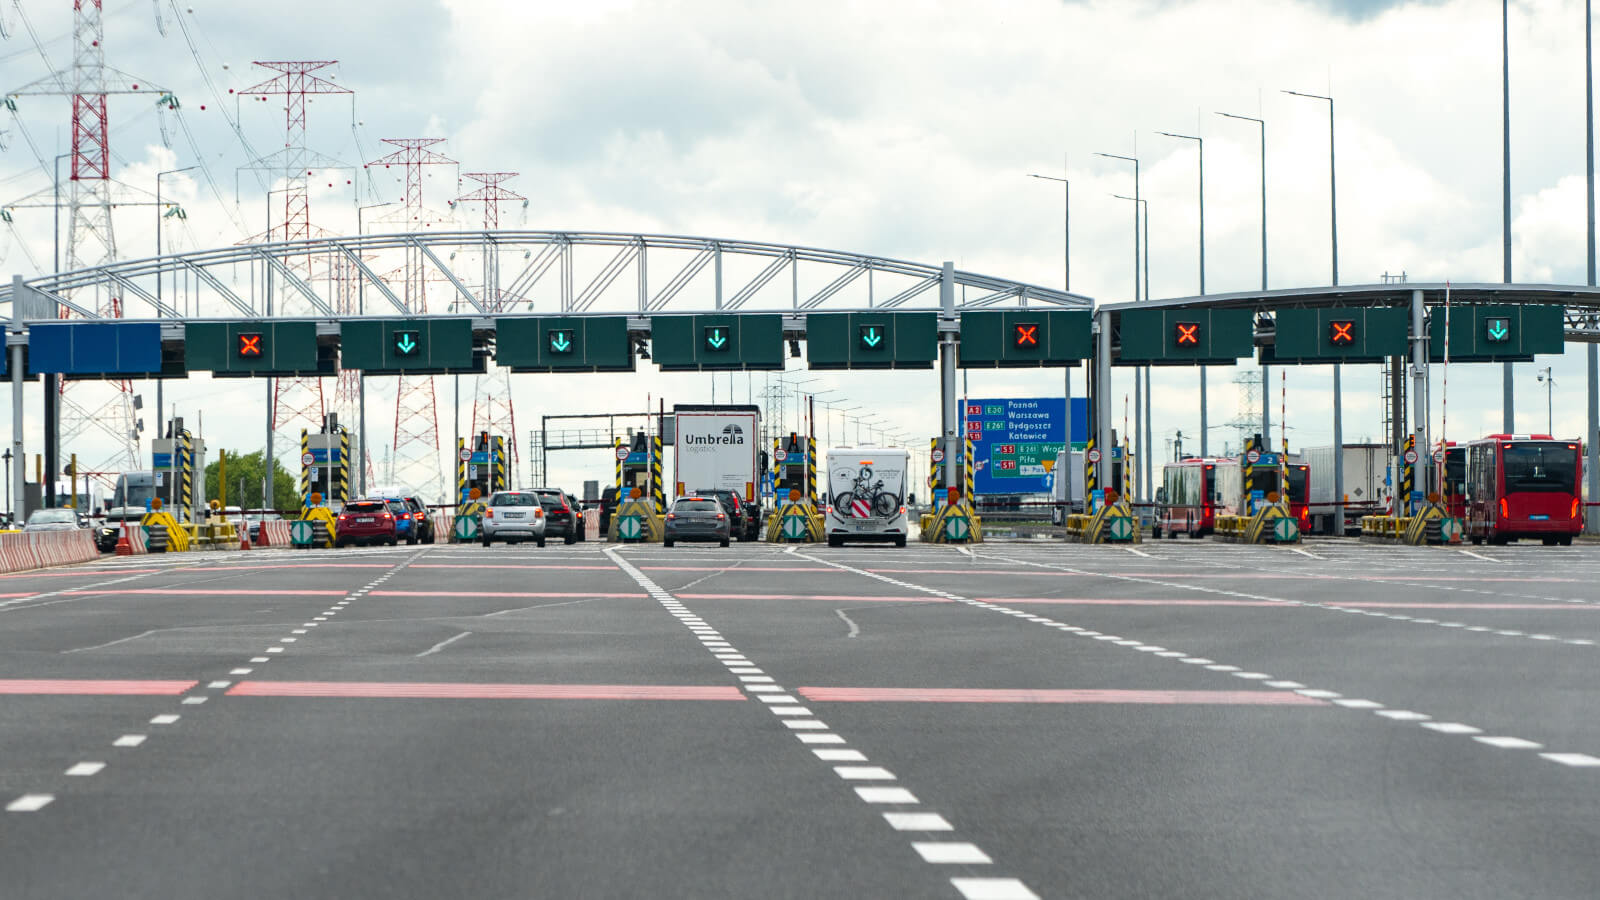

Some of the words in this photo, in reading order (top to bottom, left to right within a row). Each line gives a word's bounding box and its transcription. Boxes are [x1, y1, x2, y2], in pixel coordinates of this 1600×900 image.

[1008, 401, 1038, 409] Poznań
[1008, 411, 1049, 419] Warszawa
[685, 433, 744, 445] Umbrella
[1008, 432, 1047, 440] Katowice
[685, 445, 717, 454] Logistics
[956, 456, 963, 464] 4
